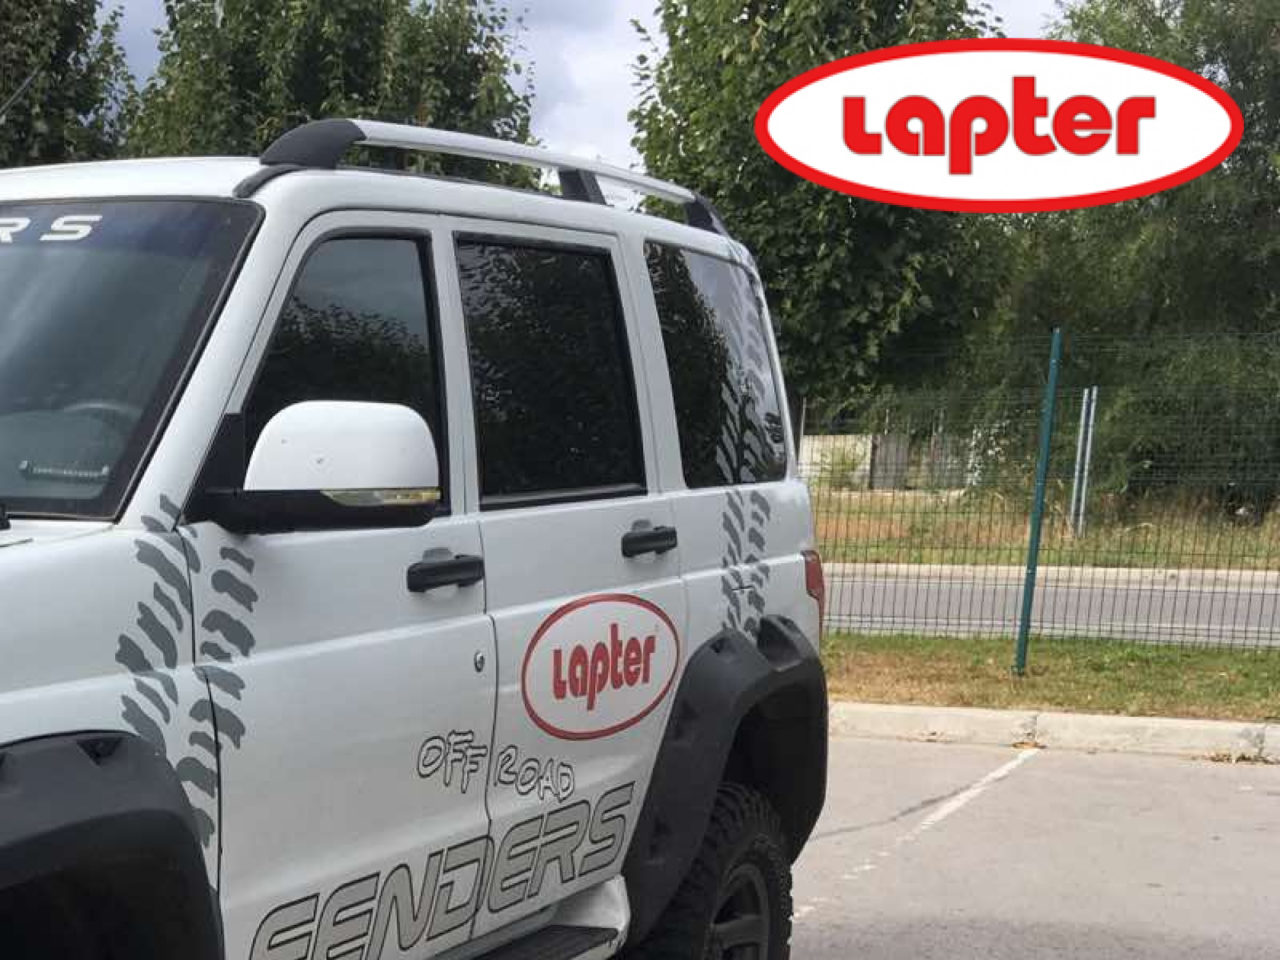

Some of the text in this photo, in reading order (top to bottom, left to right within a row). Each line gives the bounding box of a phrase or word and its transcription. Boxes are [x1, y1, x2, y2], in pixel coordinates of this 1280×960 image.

[551, 623, 658, 711] Lapter
[417, 730, 575, 802] OFF ROAD
